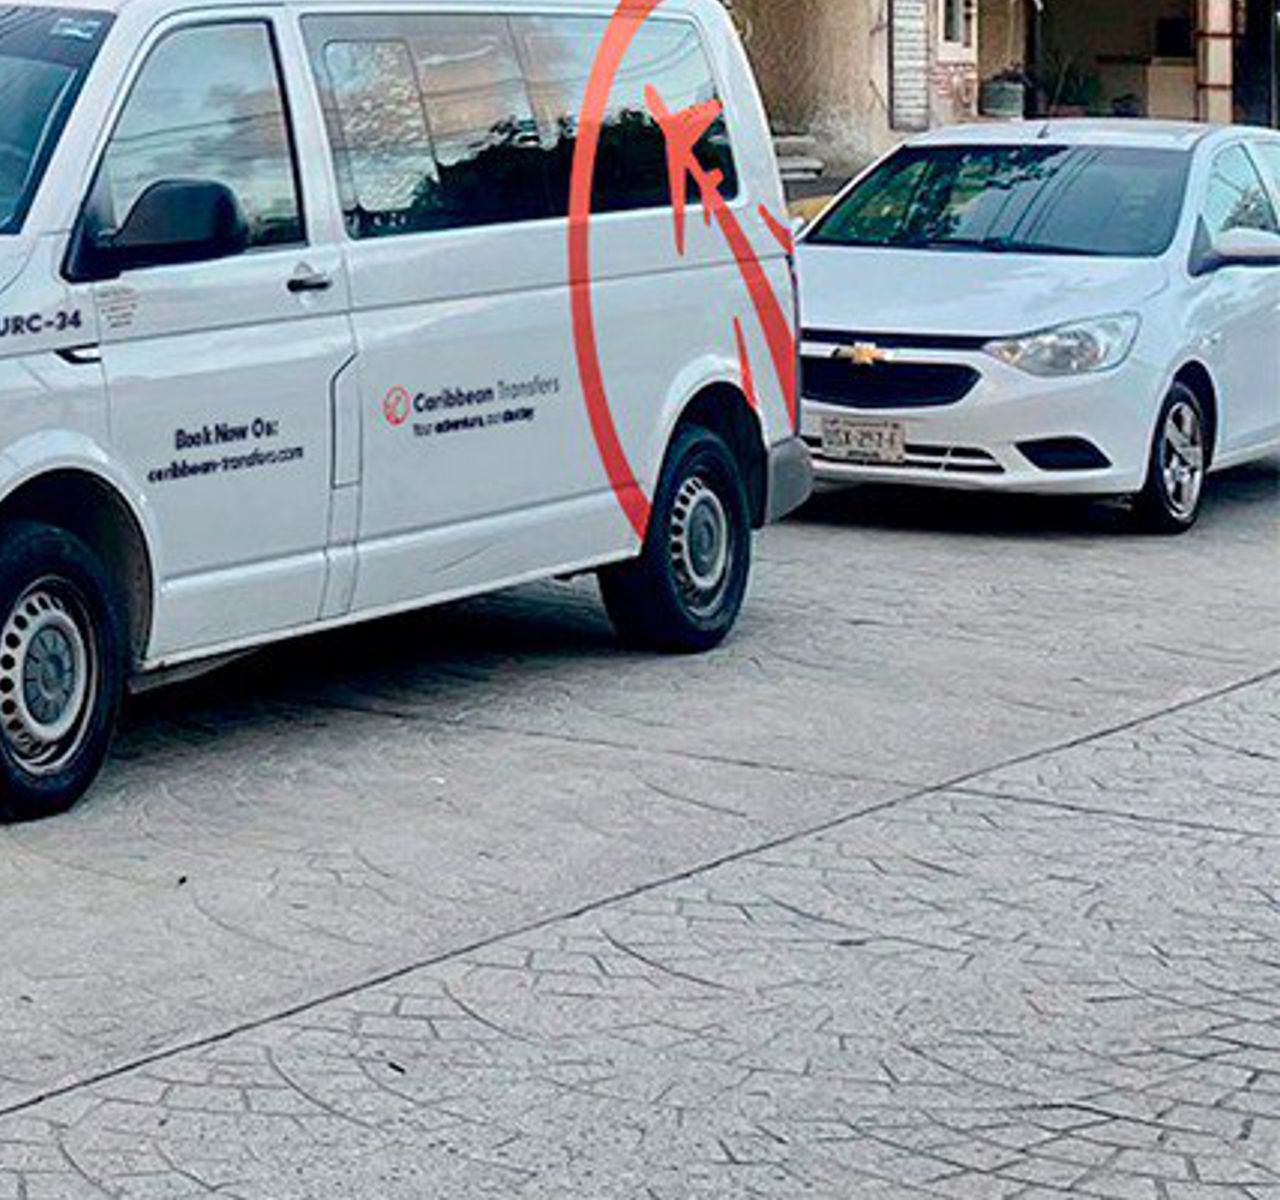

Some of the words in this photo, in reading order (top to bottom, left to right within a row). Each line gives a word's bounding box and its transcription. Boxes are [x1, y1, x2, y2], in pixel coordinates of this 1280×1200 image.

[413, 386, 494, 412] Caribbean
[497, 375, 560, 399] Transfers
[175, 427, 213, 450] Book
[214, 422, 249, 444] Now
